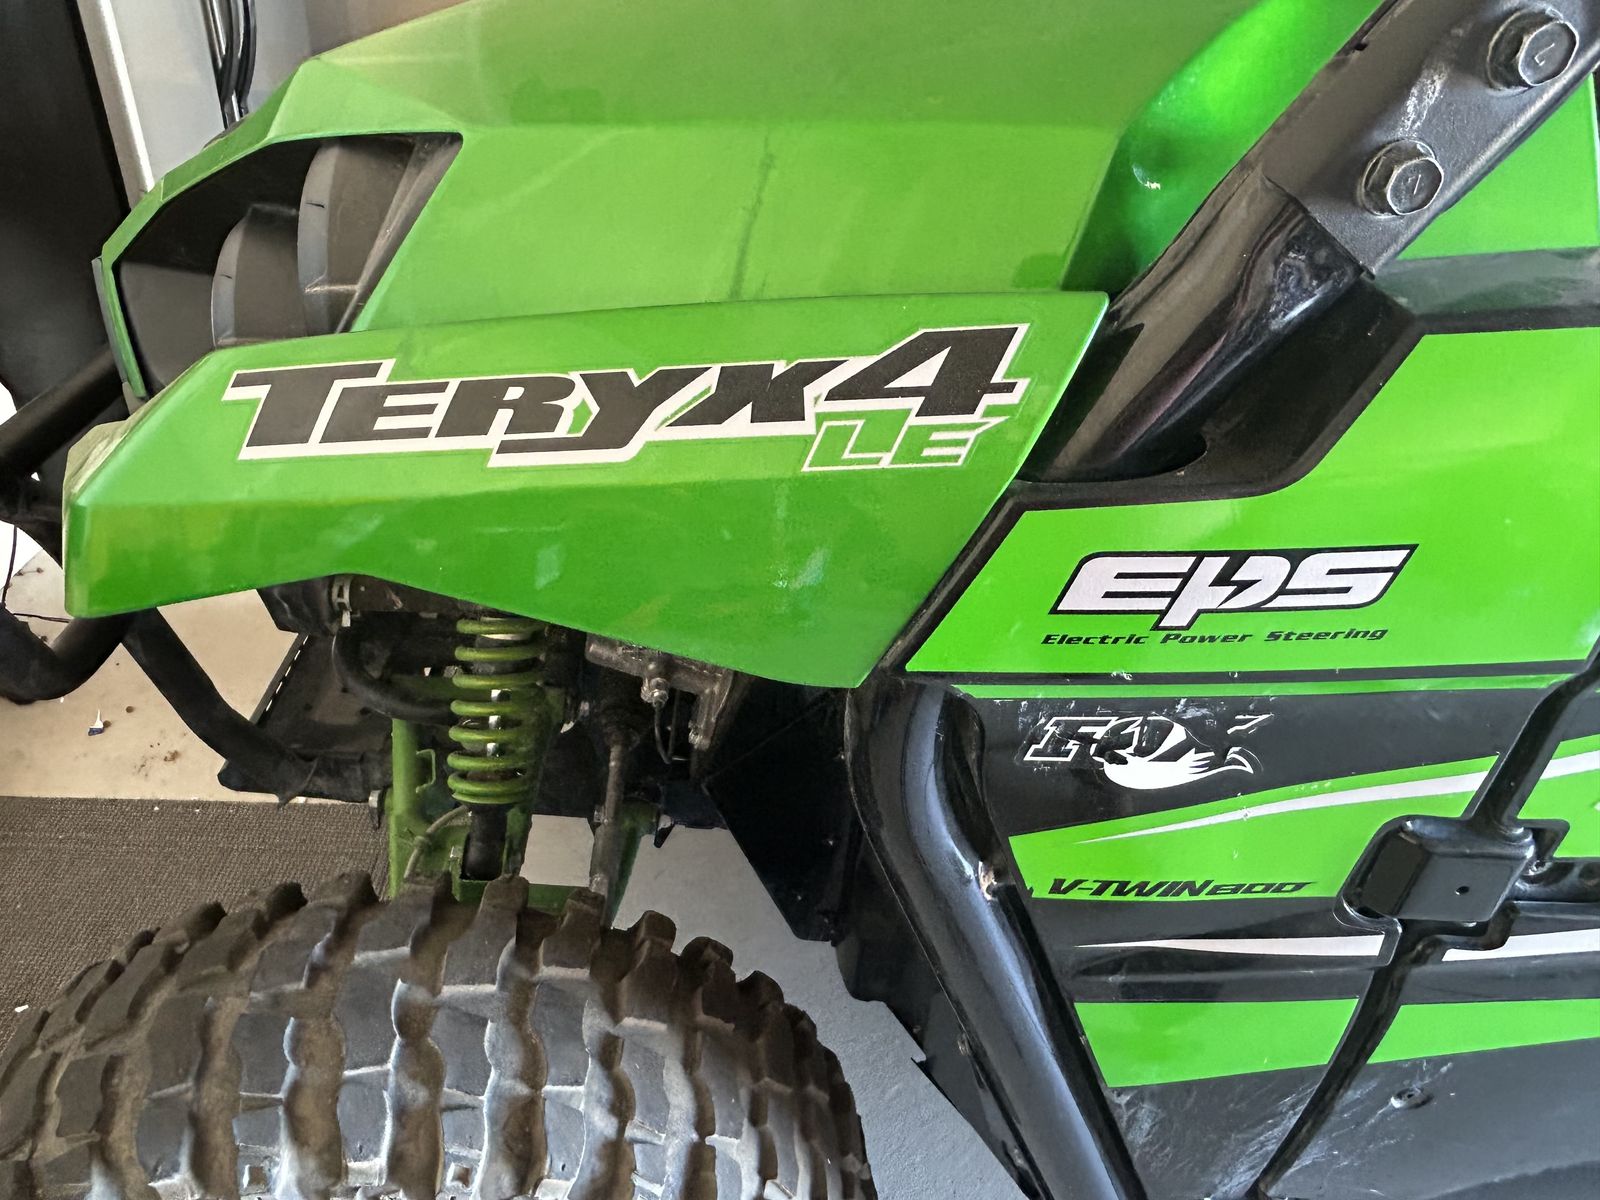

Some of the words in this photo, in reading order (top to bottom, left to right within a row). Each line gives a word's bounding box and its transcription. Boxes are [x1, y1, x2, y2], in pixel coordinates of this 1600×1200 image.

[801, 412, 1008, 473] LE
[1048, 544, 1419, 631] EPS
[1041, 633, 1146, 645] Electric
[1159, 630, 1254, 644] Power
[1263, 626, 1389, 642] Steering
